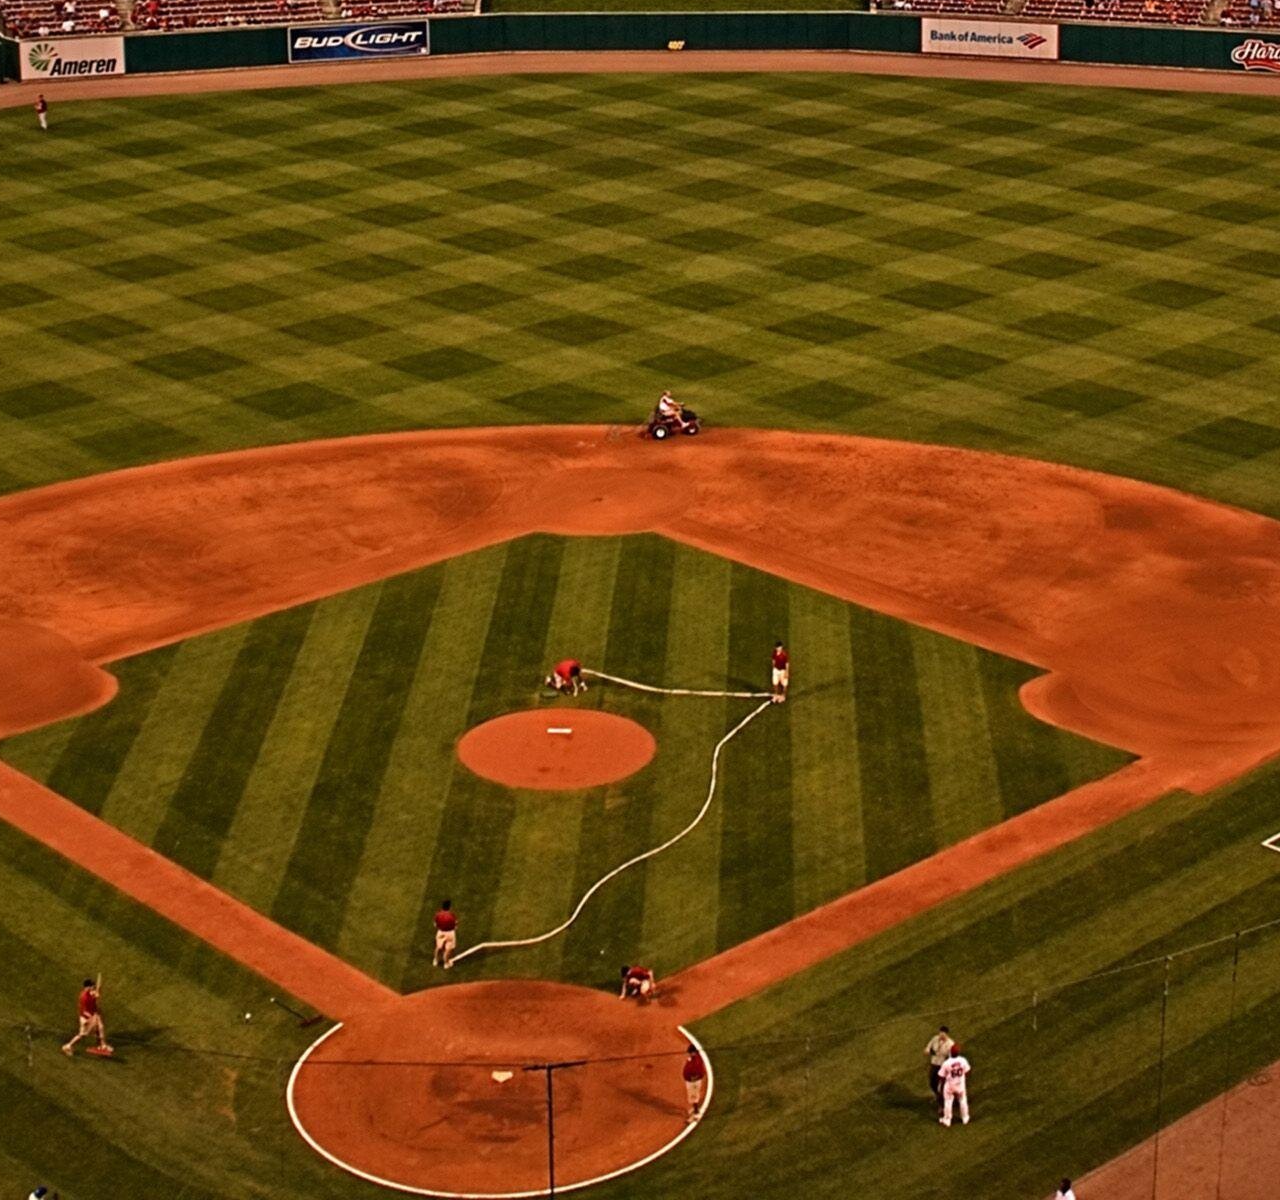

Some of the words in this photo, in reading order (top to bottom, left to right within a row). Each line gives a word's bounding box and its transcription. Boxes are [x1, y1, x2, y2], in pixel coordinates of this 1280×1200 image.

[293, 36, 344, 50] BUD
[354, 30, 423, 45] LIGHT
[930, 30, 956, 42] Bank
[957, 30, 969, 43] of
[969, 31, 1014, 45] America
[50, 57, 117, 77] Ameren
